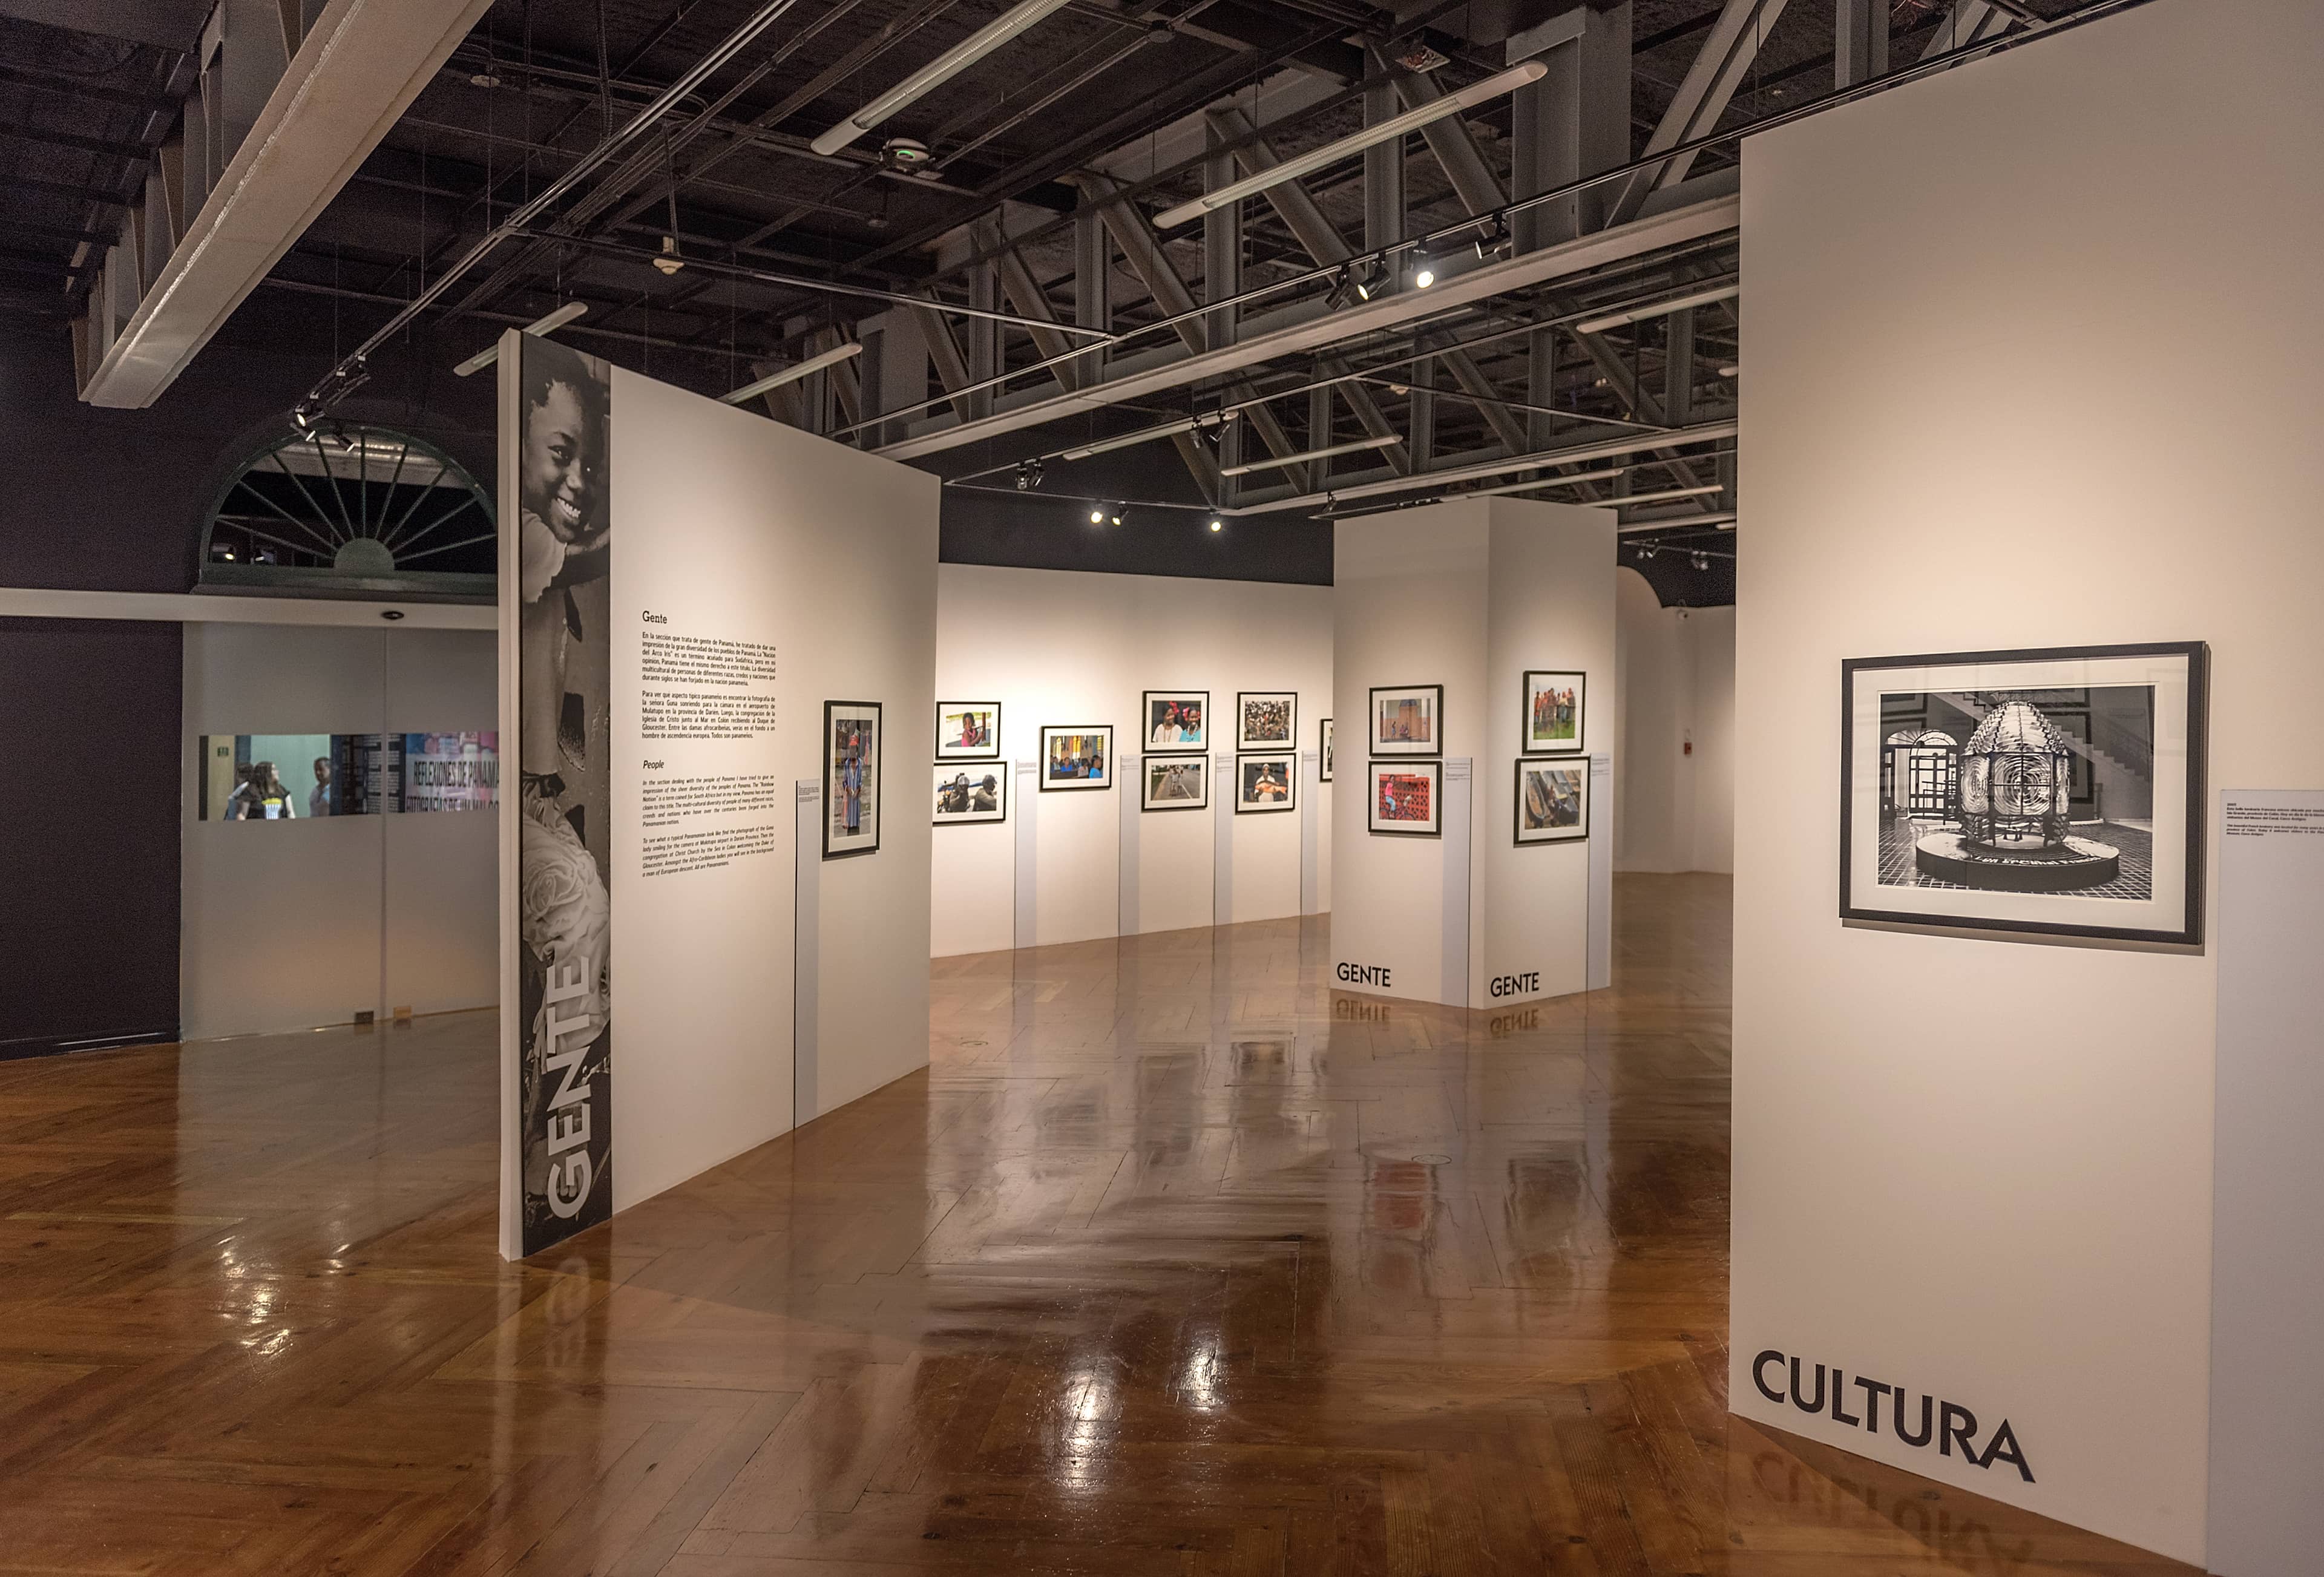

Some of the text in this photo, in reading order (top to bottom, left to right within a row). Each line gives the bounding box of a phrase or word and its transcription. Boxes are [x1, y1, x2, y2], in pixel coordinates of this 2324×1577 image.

[642, 611, 668, 624] Gente
[413, 761, 456, 787] REFLEXIONES
[458, 761, 466, 787] DE
[643, 760, 665, 770] People
[1336, 962, 1391, 987] GENTE
[1490, 972, 1540, 997] GENTE
[547, 956, 592, 1219] GENTE
[1752, 1350, 2036, 1483] CULTURA
